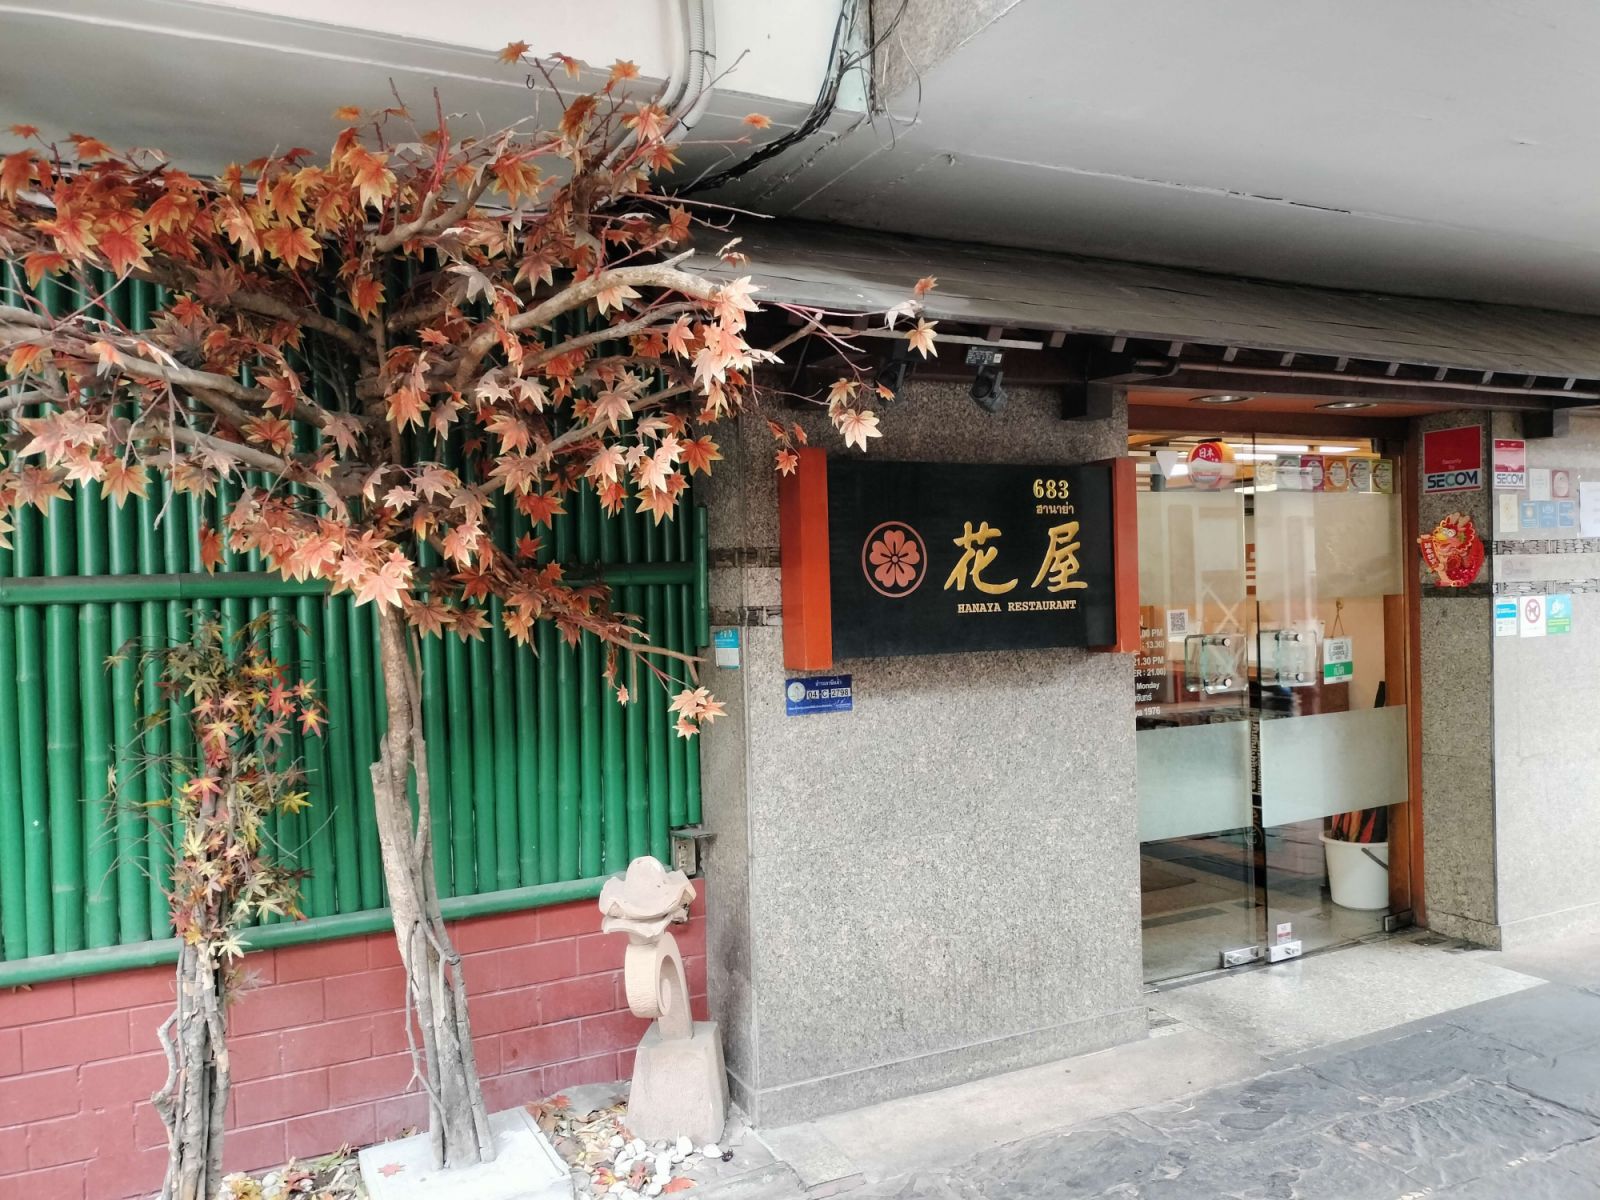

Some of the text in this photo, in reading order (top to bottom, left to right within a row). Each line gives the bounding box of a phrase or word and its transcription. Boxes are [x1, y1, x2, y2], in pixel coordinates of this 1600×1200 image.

[1427, 470, 1478, 489] SECOM
[1496, 473, 1524, 484] SECOM
[1032, 479, 1069, 499] 683
[1036, 501, 1074, 515] ฮานาย่า
[943, 521, 1088, 595] 花屋
[957, 600, 1077, 614] HANAYA RESTAURANT
[1151, 628, 1163, 637] PM
[1152, 656, 1164, 665] PM
[1136, 681, 1160, 691] Monday
[1144, 706, 1160, 715] 1976
